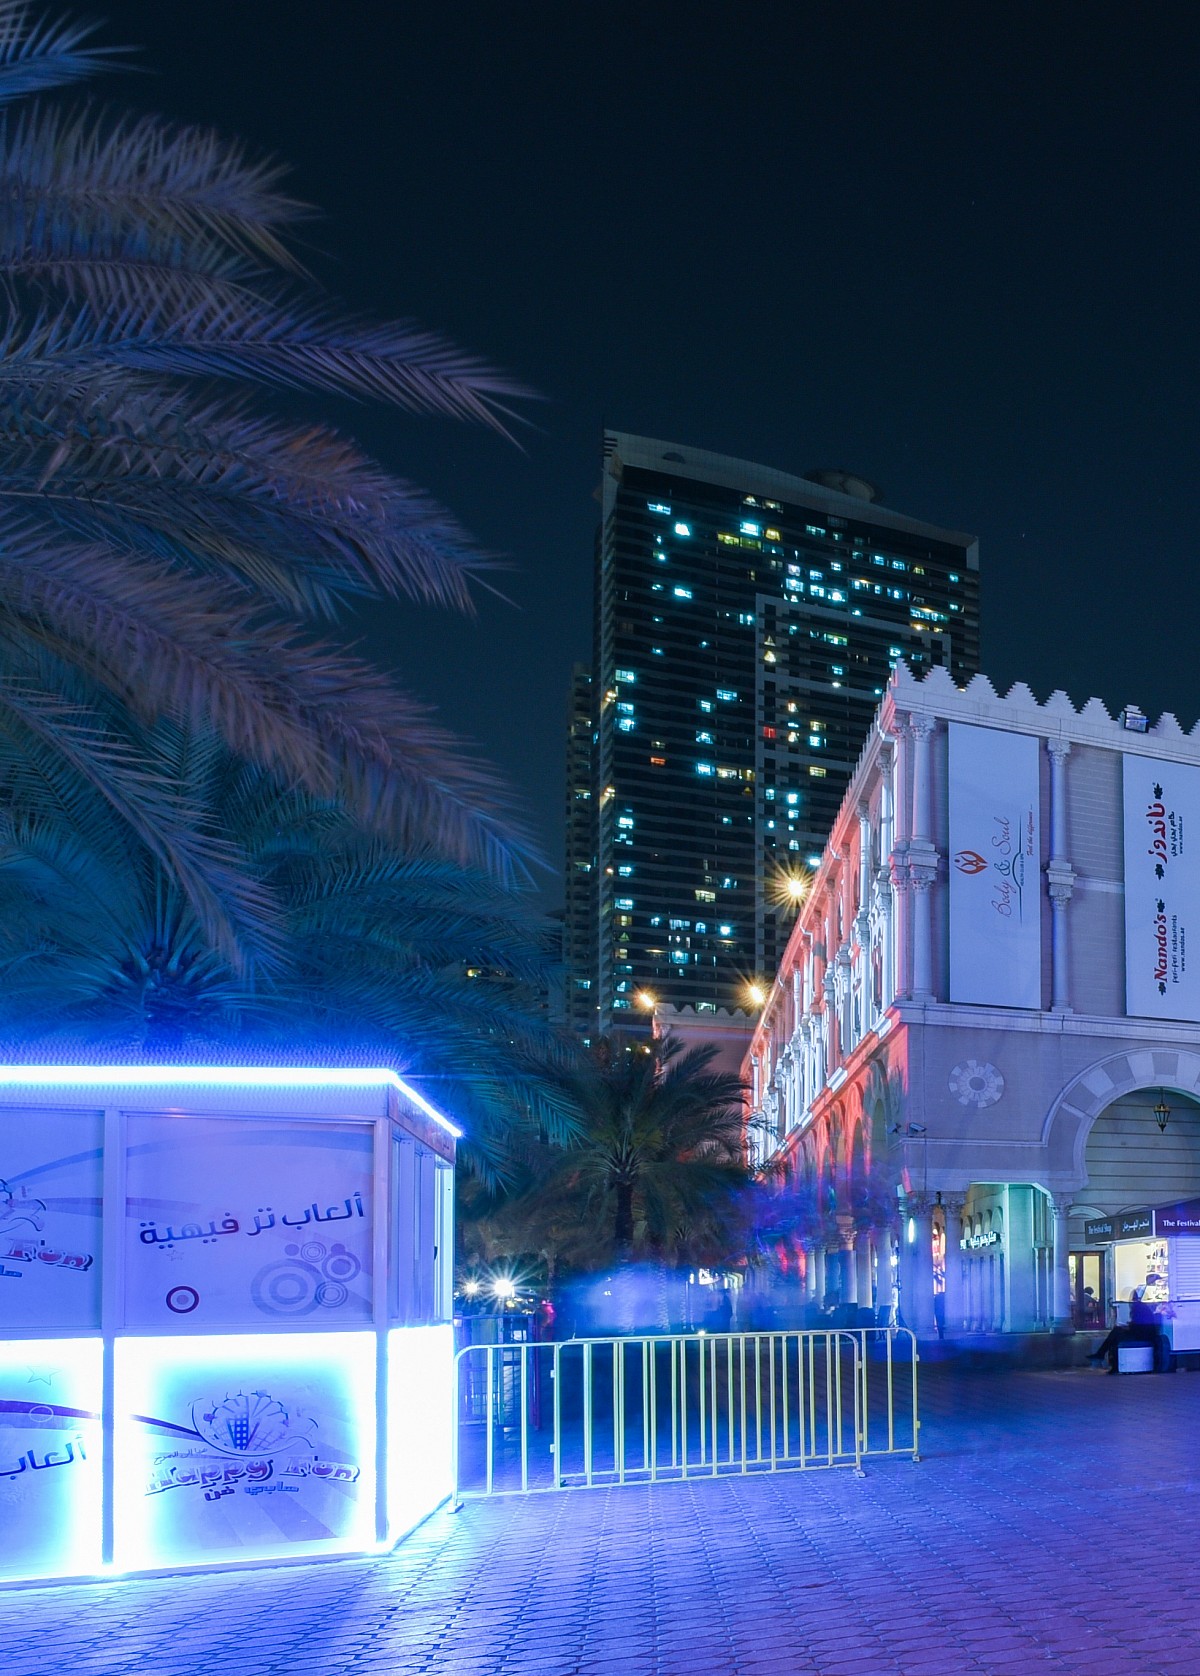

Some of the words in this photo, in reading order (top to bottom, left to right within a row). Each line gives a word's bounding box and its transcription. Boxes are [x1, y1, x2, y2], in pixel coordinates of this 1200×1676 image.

[991, 816, 1012, 855] Soul
[1146, 803, 1168, 864] ناندوز
[994, 859, 1010, 876] &
[991, 880, 1017, 918] Body
[1153, 914, 1168, 983] Nando's
[1171, 954, 1180, 984] peri-peri
[281, 1191, 365, 1231] ألعاب
[1162, 1219, 1176, 1228] The
[1177, 1219, 1200, 1228] Festival
